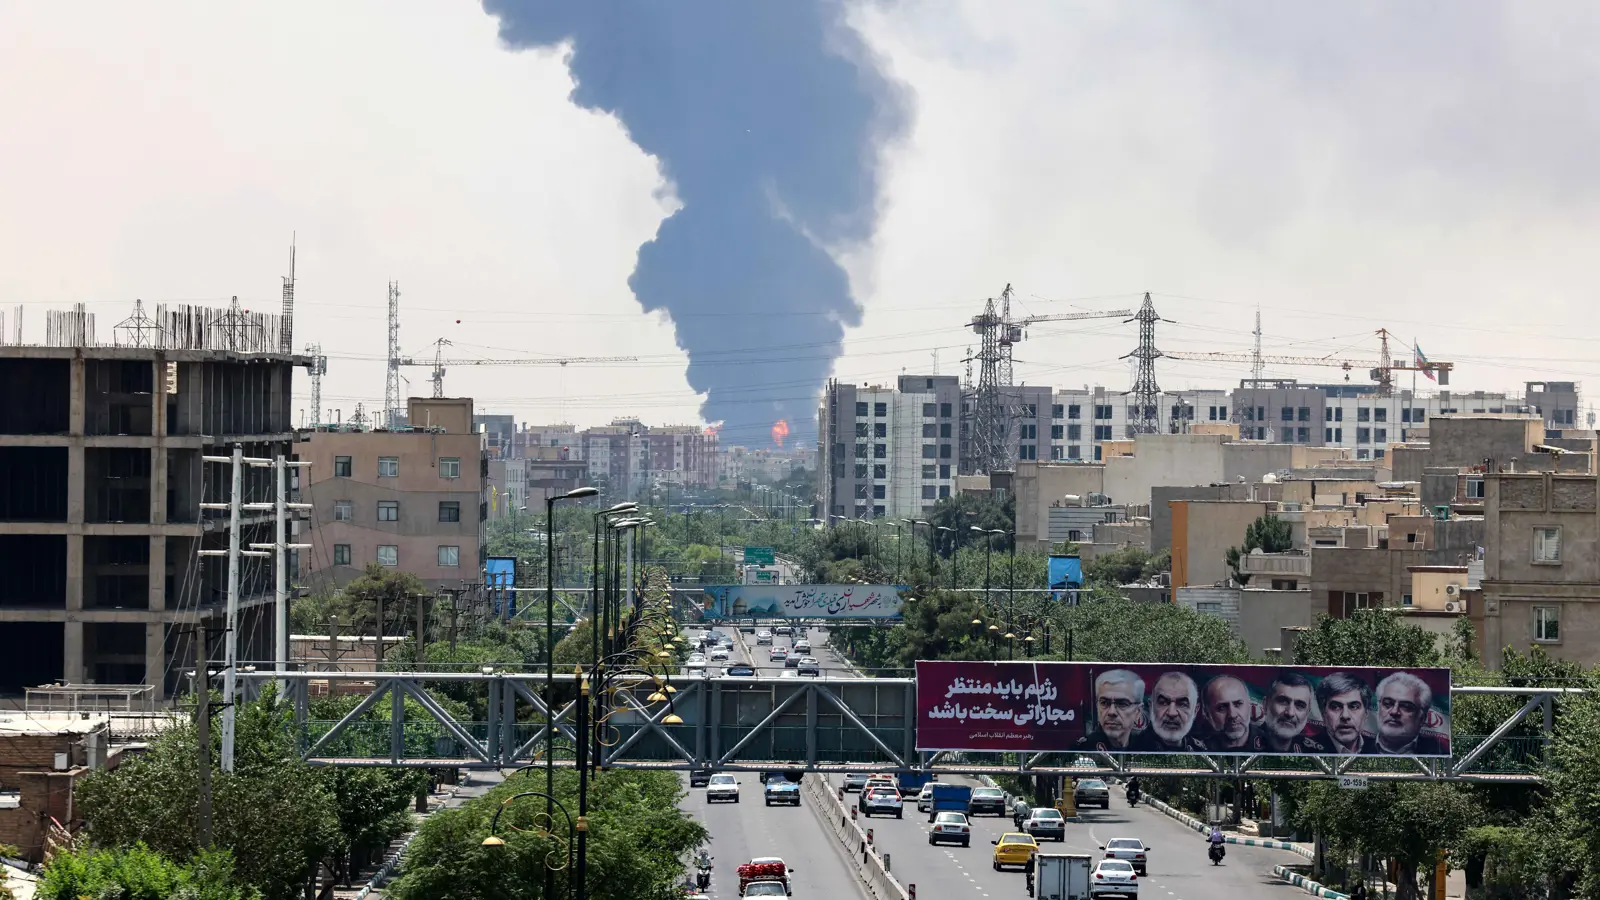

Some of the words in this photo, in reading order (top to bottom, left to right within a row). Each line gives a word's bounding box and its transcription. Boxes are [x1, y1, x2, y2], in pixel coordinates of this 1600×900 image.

[945, 676, 992, 699] منتظر
[993, 678, 1023, 700] باید
[1024, 678, 1058, 701] رژیم
[928, 700, 968, 724] باشد
[969, 702, 1013, 721] سخت
[1013, 703, 1075, 726] مجازاتی
[969, 731, 989, 740] اسلامی
[989, 731, 1006, 739] انقلاب
[1005, 732, 1022, 740] معظم
[1022, 733, 1034, 741] رهبر
